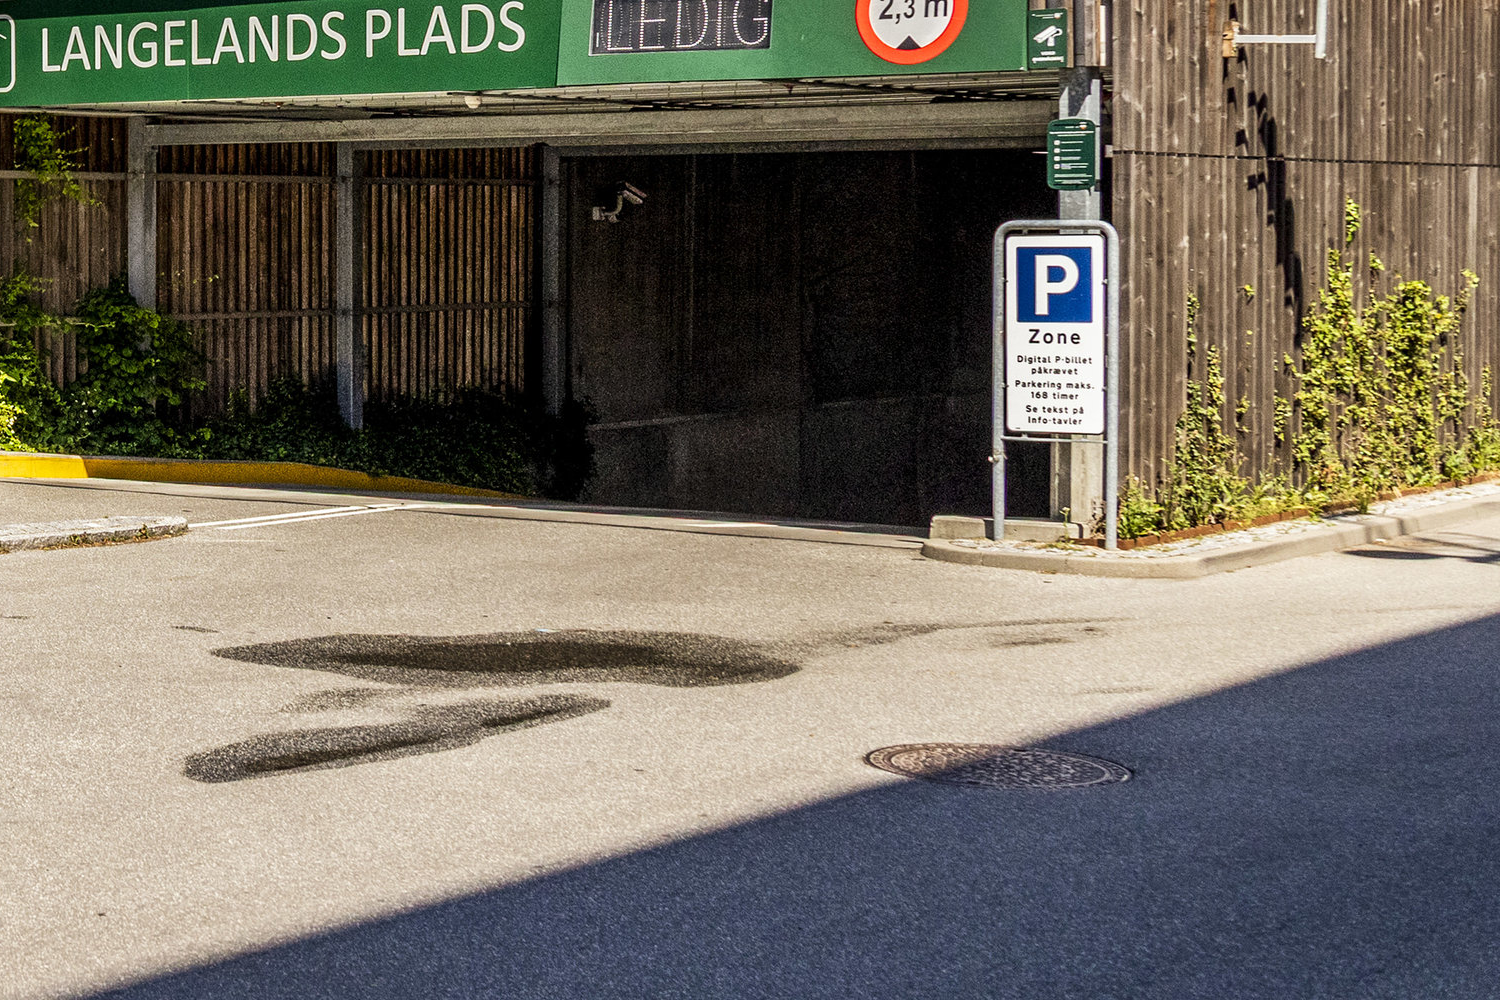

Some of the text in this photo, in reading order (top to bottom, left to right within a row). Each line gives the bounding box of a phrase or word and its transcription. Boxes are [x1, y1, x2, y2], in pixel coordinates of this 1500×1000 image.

[41, 0, 526, 72] LANGELANDS PLADS
[1034, 254, 1080, 316] P
[1028, 328, 1081, 345] Zone
[1016, 354, 1093, 365] Digital P-billet
[1031, 366, 1079, 376] påkrævet
[1014, 379, 1095, 391] Parkering maks.
[1030, 391, 1080, 400] 168 timer
[1025, 404, 1085, 415] Se tekst på
[1027, 416, 1083, 426] Info-tavler
